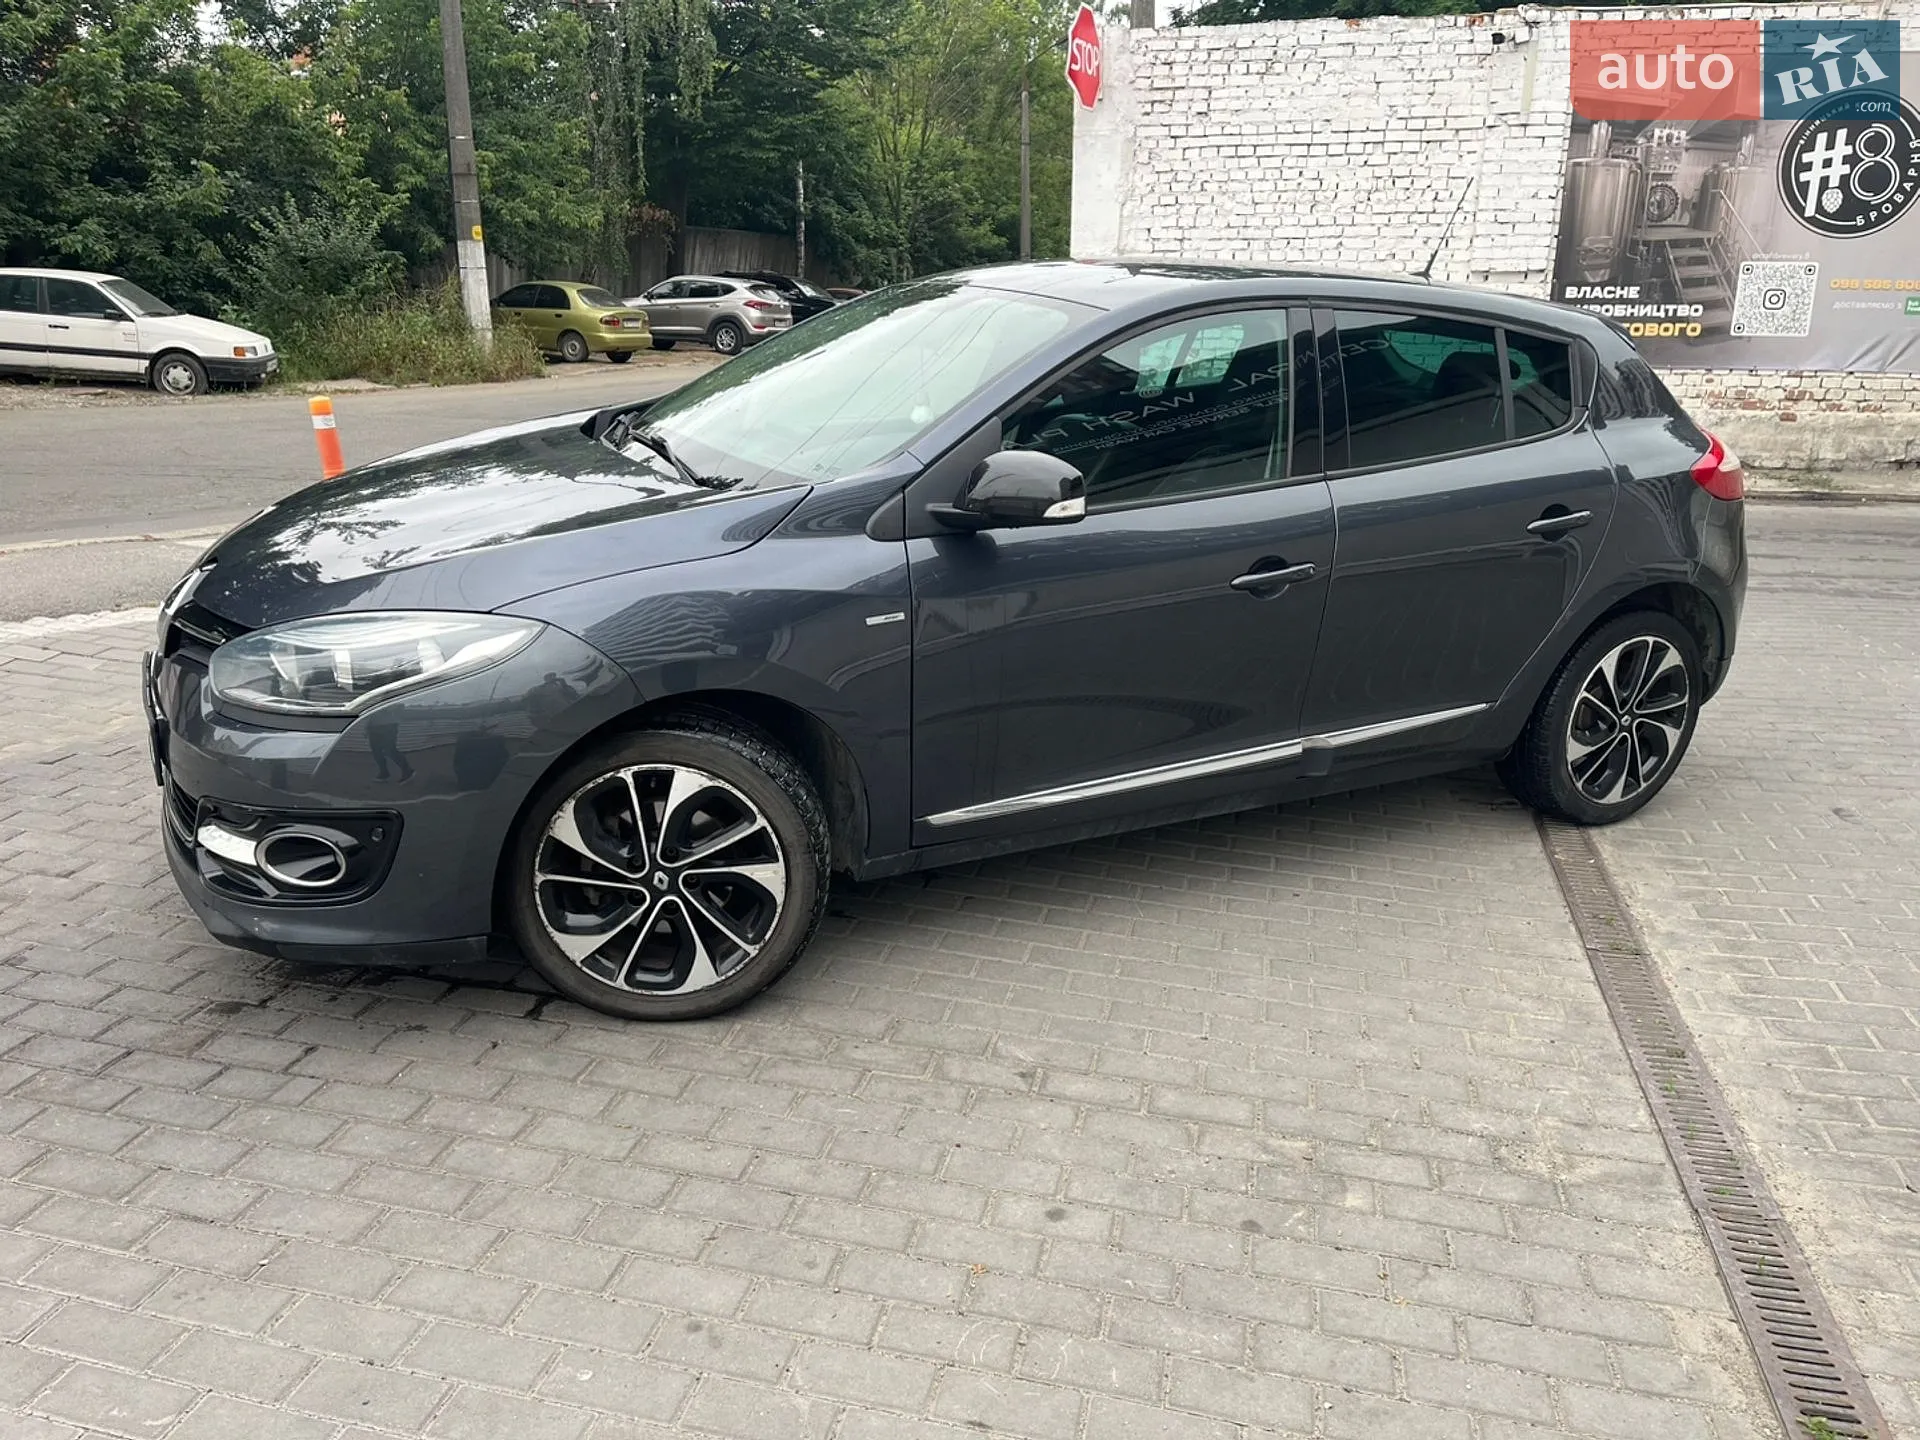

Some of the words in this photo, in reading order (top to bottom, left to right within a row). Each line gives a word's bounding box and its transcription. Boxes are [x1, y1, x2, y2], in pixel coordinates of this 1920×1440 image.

[1070, 37, 1099, 77] STOP
[1856, 138, 1920, 226] БРОВАРНЯ
[1565, 286, 1640, 299] ВЛАСНЕ
[1575, 304, 1704, 318] РОБНИЦТВО
